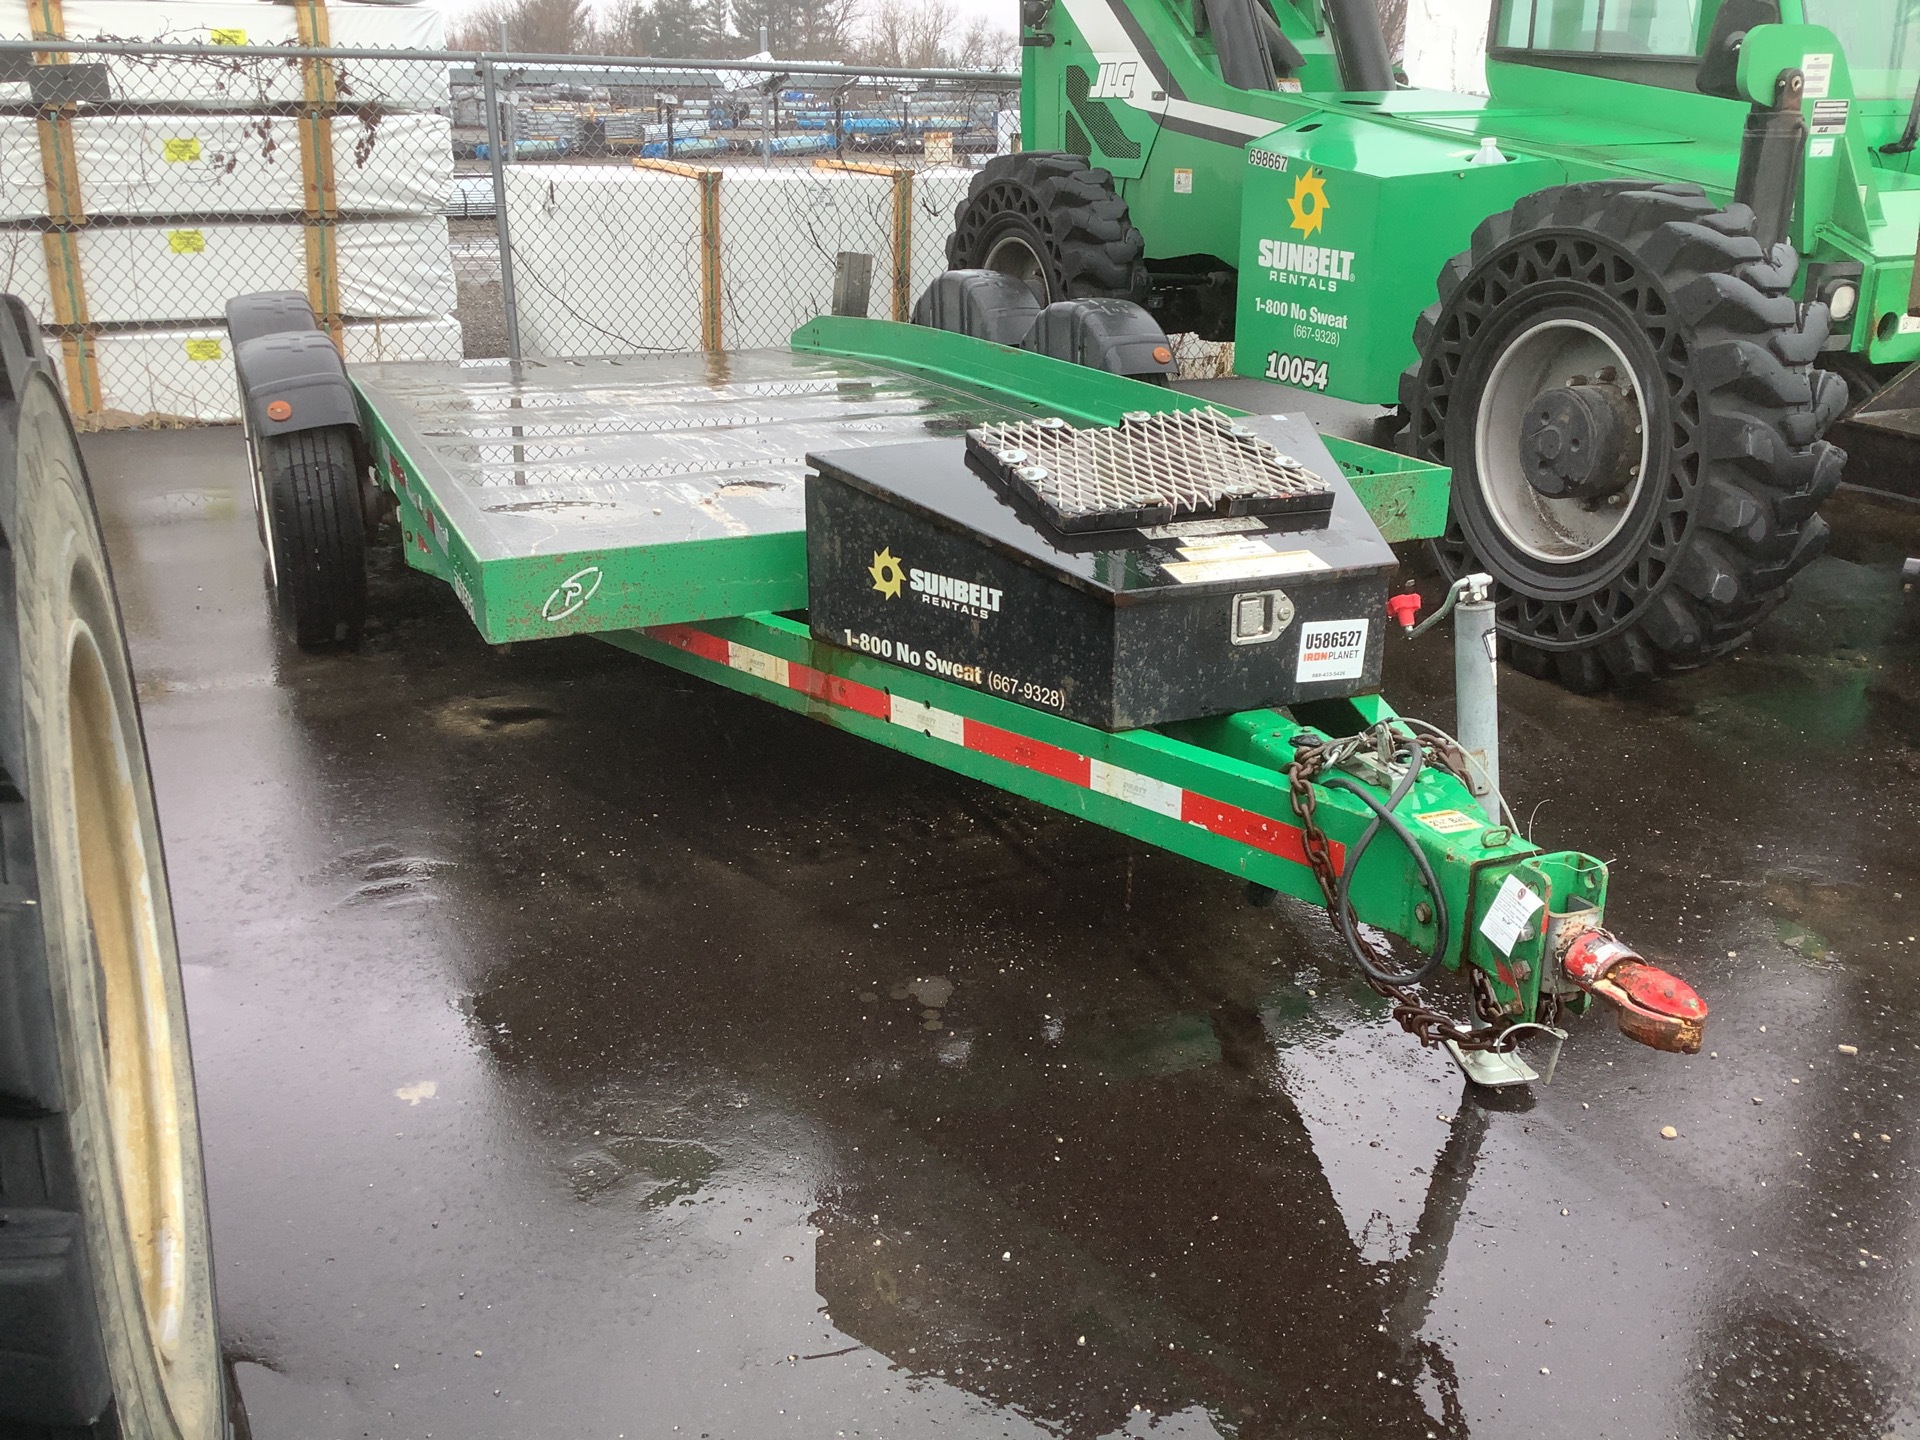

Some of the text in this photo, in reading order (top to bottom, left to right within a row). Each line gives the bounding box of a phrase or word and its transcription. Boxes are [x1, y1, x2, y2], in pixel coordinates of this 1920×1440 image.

[1088, 61, 1138, 99] JLG
[1249, 148, 1288, 171] 698667
[1258, 238, 1355, 281] SUNBELT
[1269, 270, 1337, 293] RENTALS
[1255, 297, 1348, 330] 1-800 No Sweat
[1293, 322, 1340, 348] (667-9328)
[1264, 350, 1330, 392] 10054
[909, 567, 1004, 613] SUNBELT
[921, 594, 990, 620] RENTALS
[1305, 630, 1362, 650] U586527
[843, 628, 1065, 711] 1-800 No Sweat (667-9328)
[1303, 649, 1360, 662] IRONPLANET
